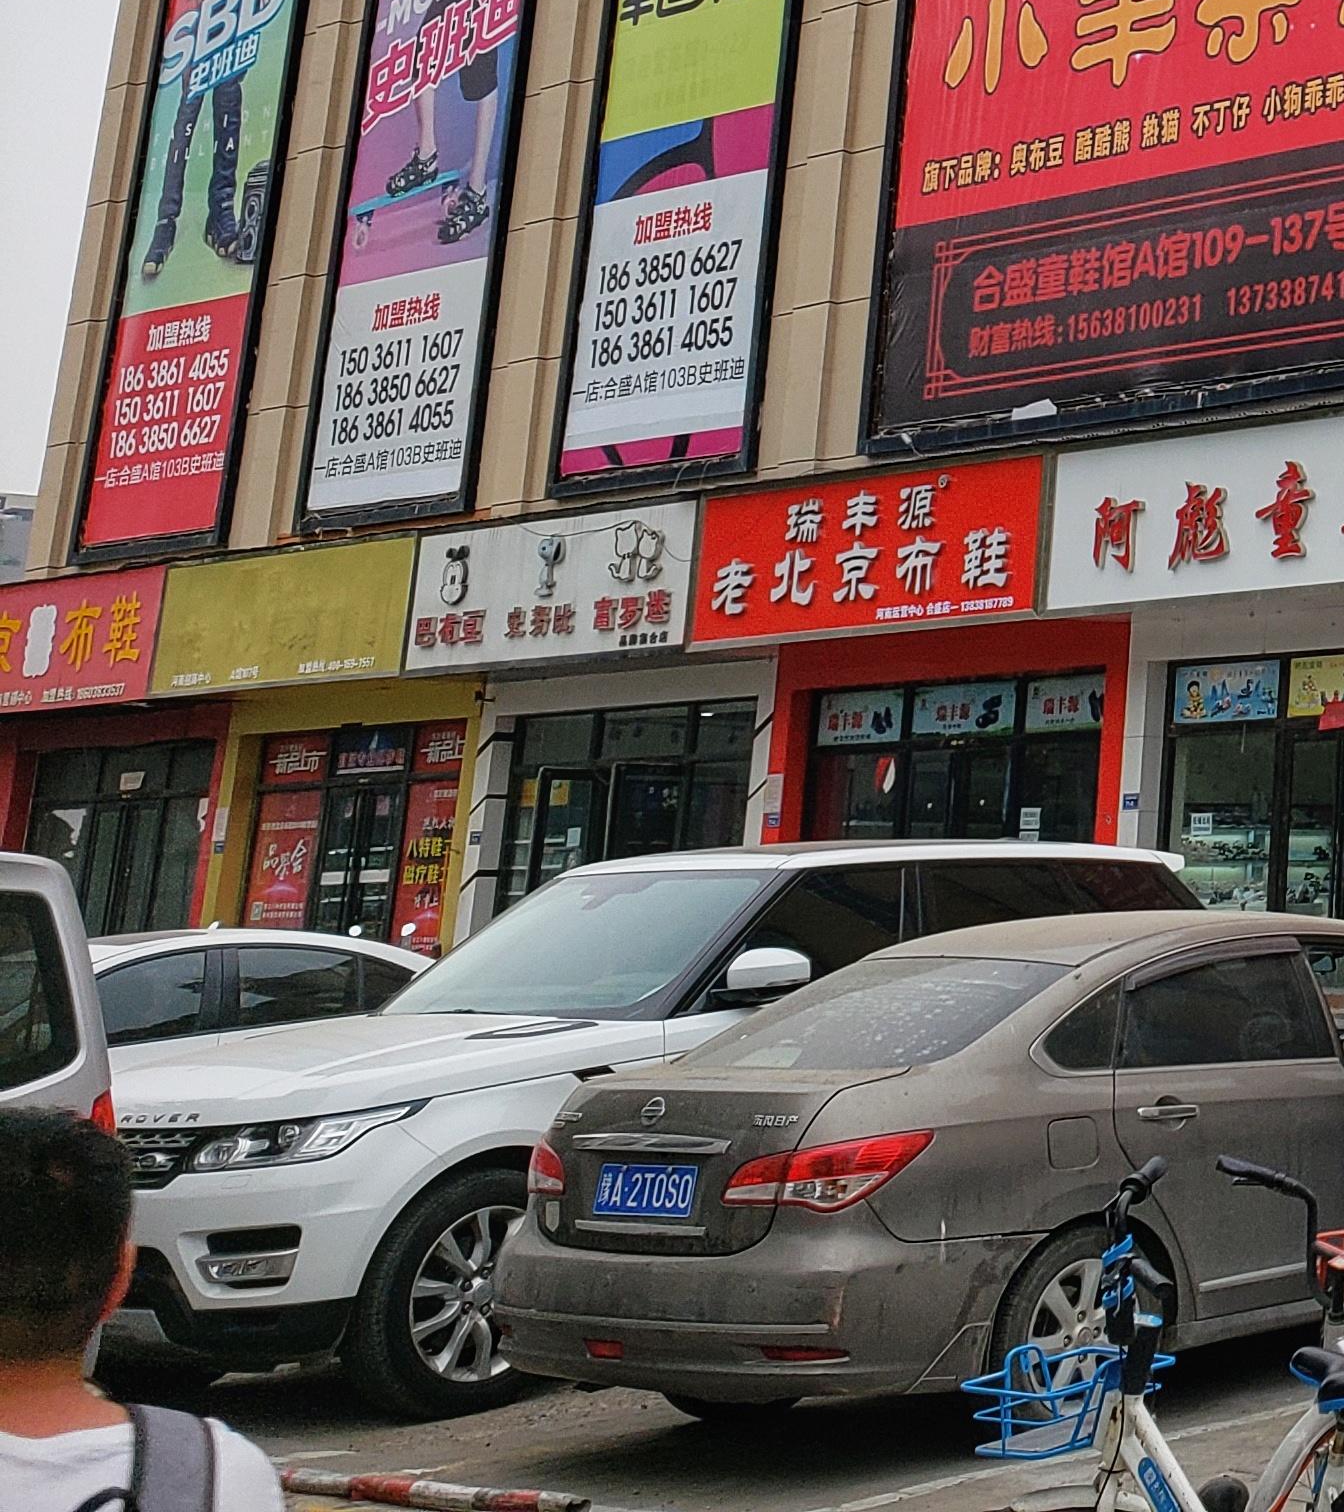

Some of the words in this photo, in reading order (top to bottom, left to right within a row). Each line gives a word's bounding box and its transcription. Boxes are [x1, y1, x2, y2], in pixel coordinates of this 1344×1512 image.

[187, 32, 261, 102] 史班迪
[1010, 136, 1064, 177] 奥布豆
[1074, 120, 1132, 164] 酷酷熊
[1141, 108, 1182, 150] 热猫
[1193, 95, 1253, 139] 不丁仔
[633, 201, 713, 246] 加盟热线
[599, 260, 631, 295] 186
[635, 249, 686, 288] 3850
[690, 238, 743, 278] 6627
[371, 292, 441, 332] 加盟热线
[594, 296, 628, 332] 150
[631, 288, 677, 326] 3611
[689, 277, 738, 316] 1607
[146, 314, 212, 352] 加盟热线
[339, 345, 369, 378] 150
[371, 337, 412, 372] 3611
[421, 328, 464, 364] 1607
[590, 334, 623, 369] 186
[627, 325, 675, 363] 3861
[680, 315, 734, 353] 4055
[118, 363, 145, 395] 186
[147, 357, 186, 389] 3861
[188, 348, 230, 381] 4055
[335, 379, 364, 412] 186
[367, 372, 411, 407] 3850
[414, 363, 461, 399] 6627
[113, 396, 141, 427] 150
[143, 389, 181, 423] 3611
[186, 380, 226, 414] 1607
[331, 414, 359, 447] 186
[362, 407, 404, 441] 3861
[408, 399, 454, 434] 4055
[109, 428, 137, 459] 186
[138, 421, 178, 455] 3850
[180, 414, 221, 447] 6627
[785, 484, 935, 543] 瑞丰源
[711, 526, 1012, 616] 老北京布鞋
[120, 1112, 200, 1125] ROVER
